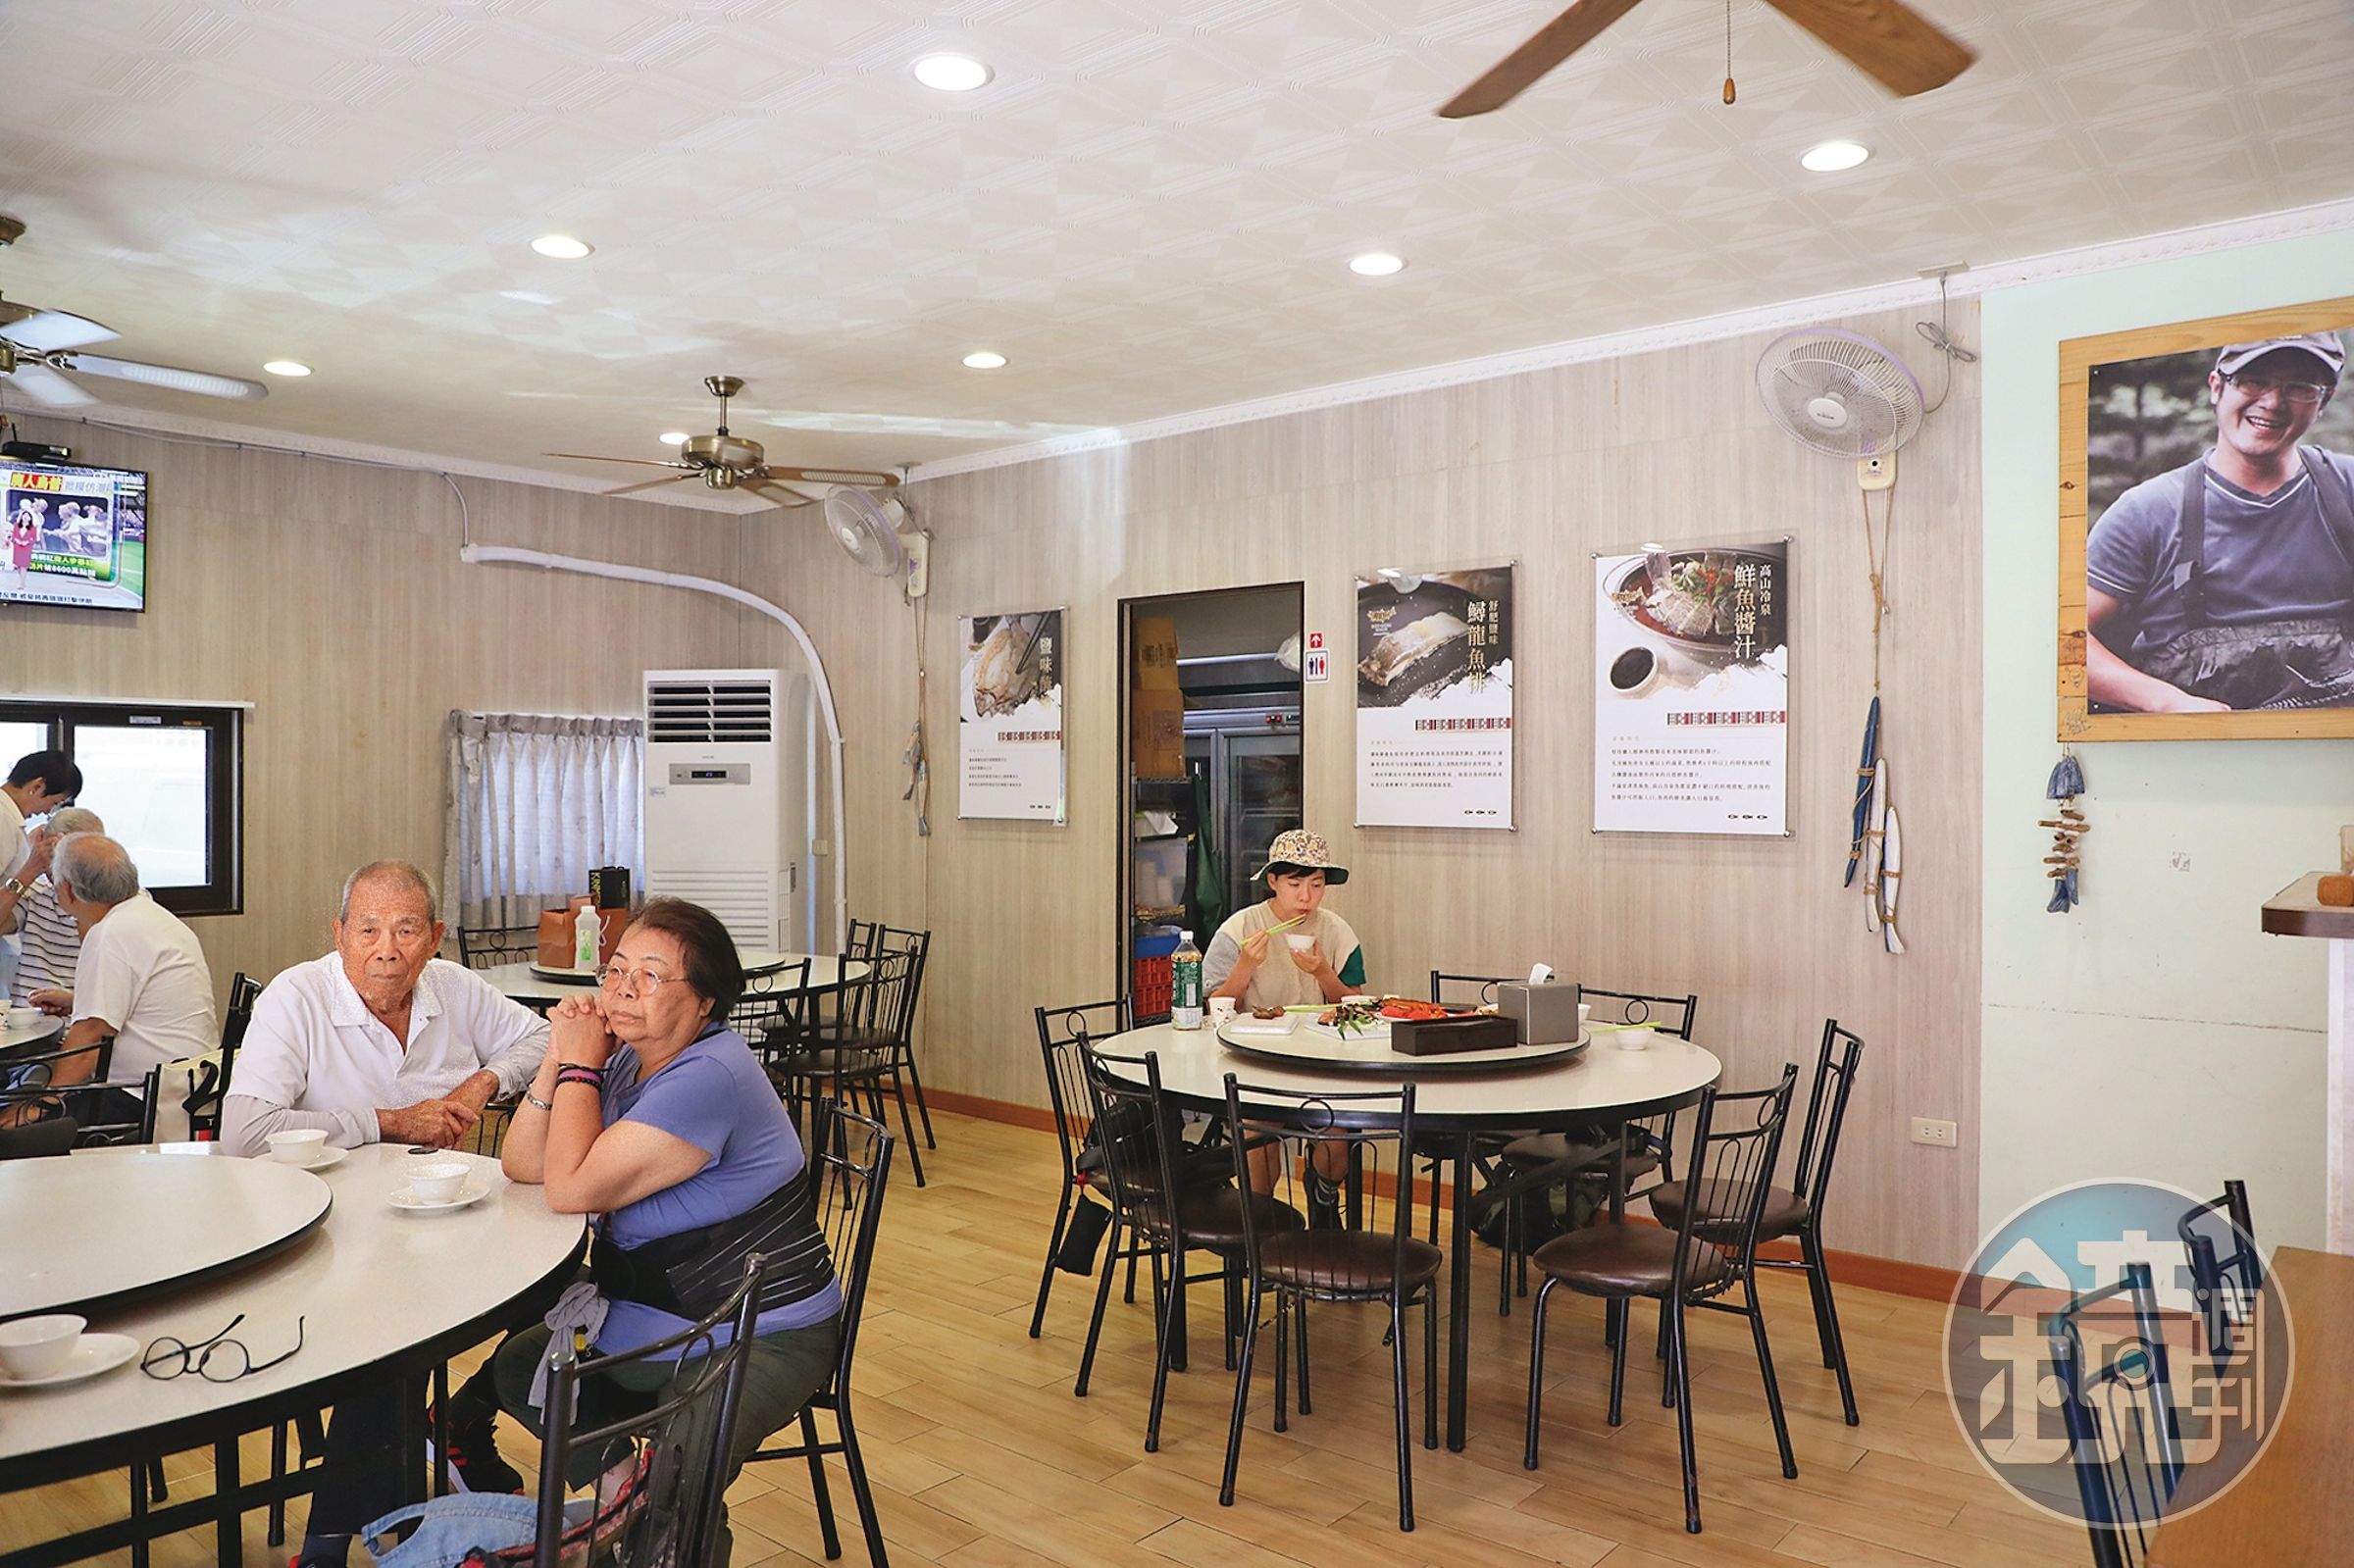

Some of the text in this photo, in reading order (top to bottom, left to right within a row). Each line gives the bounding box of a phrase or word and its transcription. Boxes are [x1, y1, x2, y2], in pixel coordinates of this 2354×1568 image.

[1734, 563, 1756, 660] 鮮魚醬汁
[1760, 564, 1771, 616] 高山冷泉
